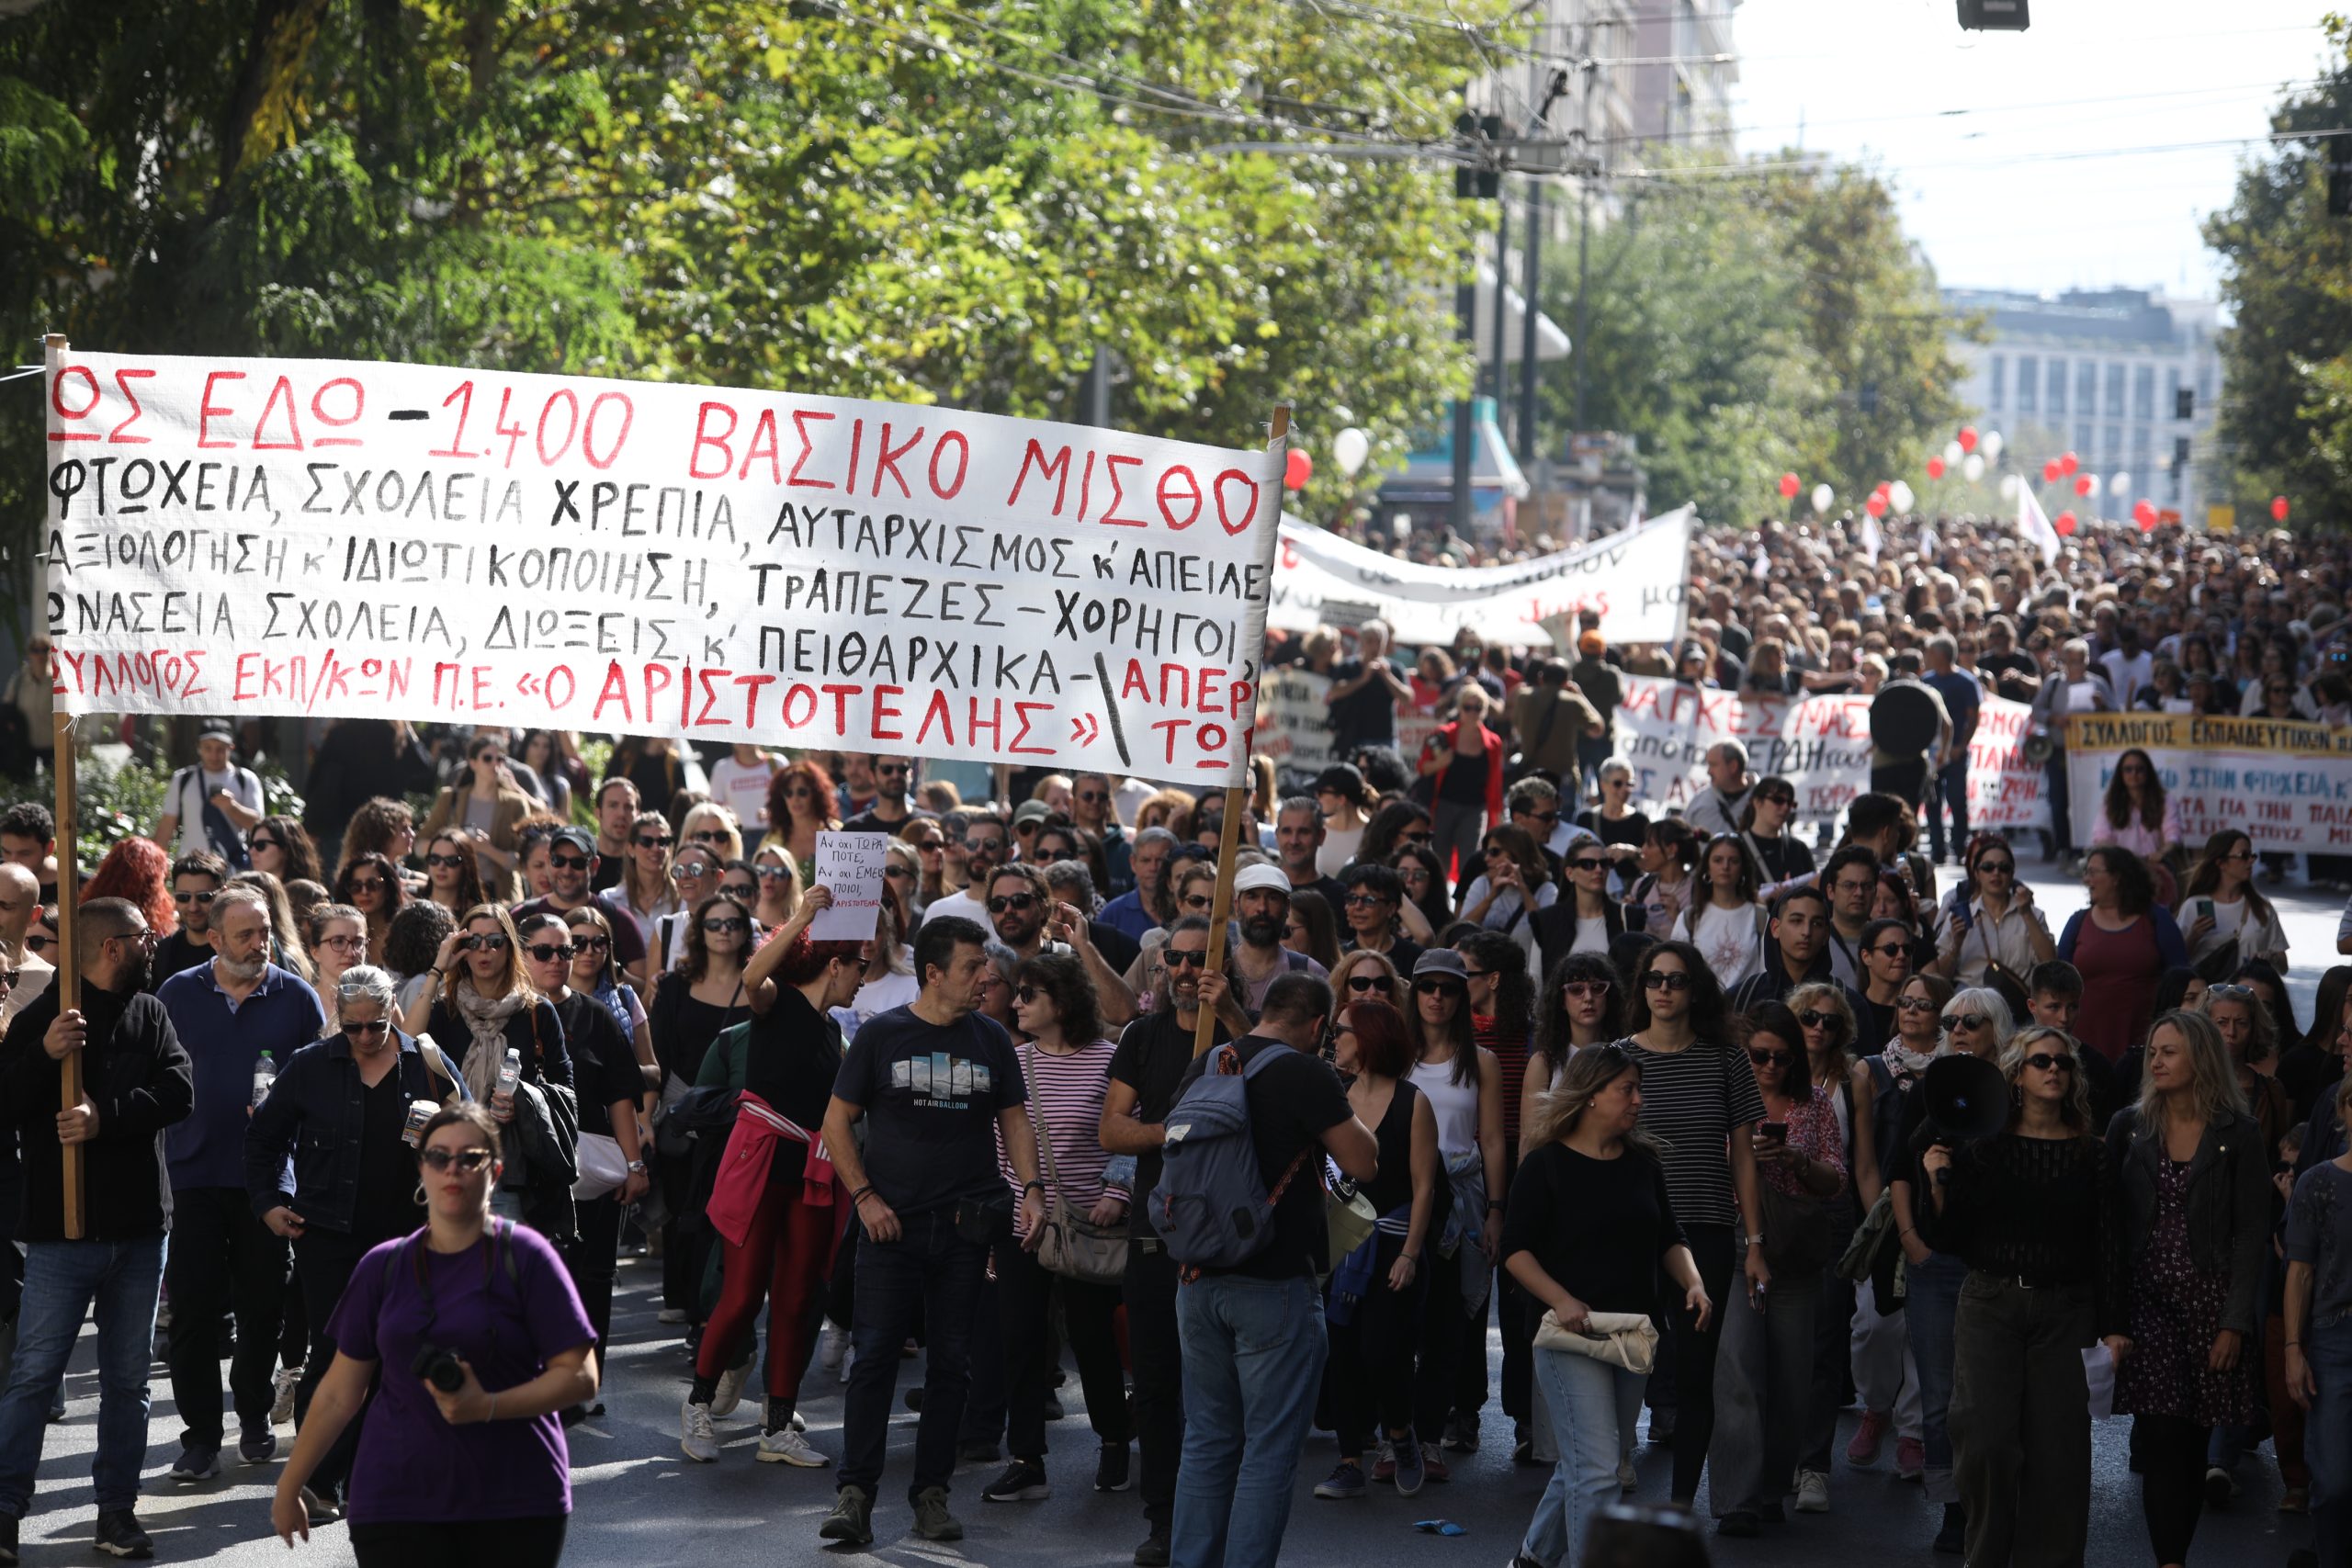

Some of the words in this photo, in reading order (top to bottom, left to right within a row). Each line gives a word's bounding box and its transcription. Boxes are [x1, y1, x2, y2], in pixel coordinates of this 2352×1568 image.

[48, 366, 156, 444] ΩΣ
[198, 371, 365, 450] ΕΔΩ
[689, 401, 968, 500] ΒΑΣΙΚΟ
[1007, 438, 1259, 536] ΜΙΣΘΟ
[48, 529, 288, 583] ΑΞΙΟΛΟΓΗΣΗ
[50, 457, 281, 527] ΦΤΩΧΕΙΑ,
[301, 462, 523, 525] ΣΧΟΛΕΙΑ
[550, 479, 751, 560] ΧΡΕΠΙΑ,
[767, 502, 1080, 579] ΑΥΤΑΡΧΙΣΜΟΣ
[1130, 547, 1273, 603] ΑΠΕΙΛΕ
[262, 592, 467, 659] ΣΧΟΛΕΙΑ,
[484, 604, 679, 660] ΔΙΩΞΕΙΣ
[433, 662, 504, 711] Π.Ε.
[593, 659, 1099, 755] ΑΡΙΣΤΟΤΕΛΗΣ»
[1122, 658, 1260, 721] ΑΠΕΡ
[1747, 737, 1826, 774] ΕΡΔΗ
[2082, 719, 2177, 746] ΣΥΛΛΟΓΟΣ
[913, 1099, 927, 1107] HOT
[927, 1100, 939, 1108] AIR
[939, 1100, 968, 1110] BALLOON
